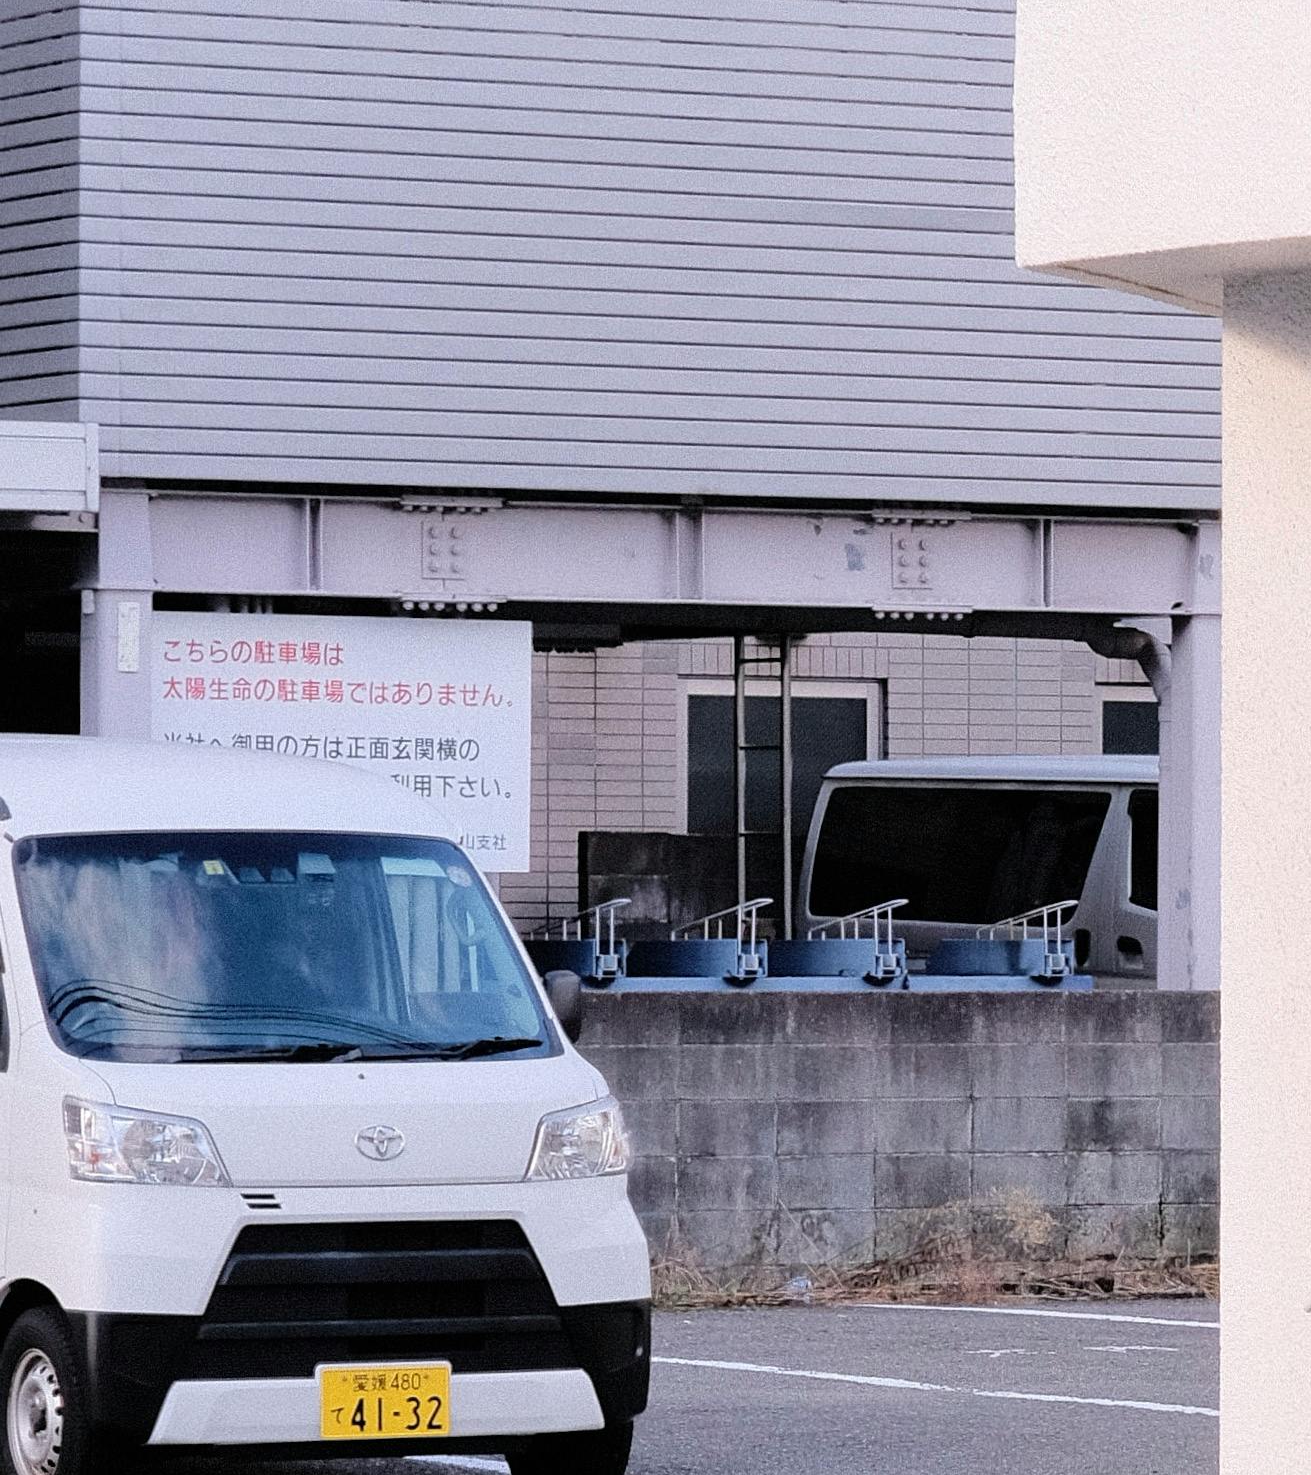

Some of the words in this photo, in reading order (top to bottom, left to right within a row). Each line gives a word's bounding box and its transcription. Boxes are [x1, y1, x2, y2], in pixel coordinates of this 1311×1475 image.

[163, 640, 344, 666] こちらの駐車場は
[162, 677, 514, 708] 太陽生命の駐車場ではありません。
[353, 1374, 387, 1392] 愛媛
[390, 1373, 421, 1390] 480
[331, 1407, 345, 1424] て
[351, 1396, 442, 1432] 41-32
